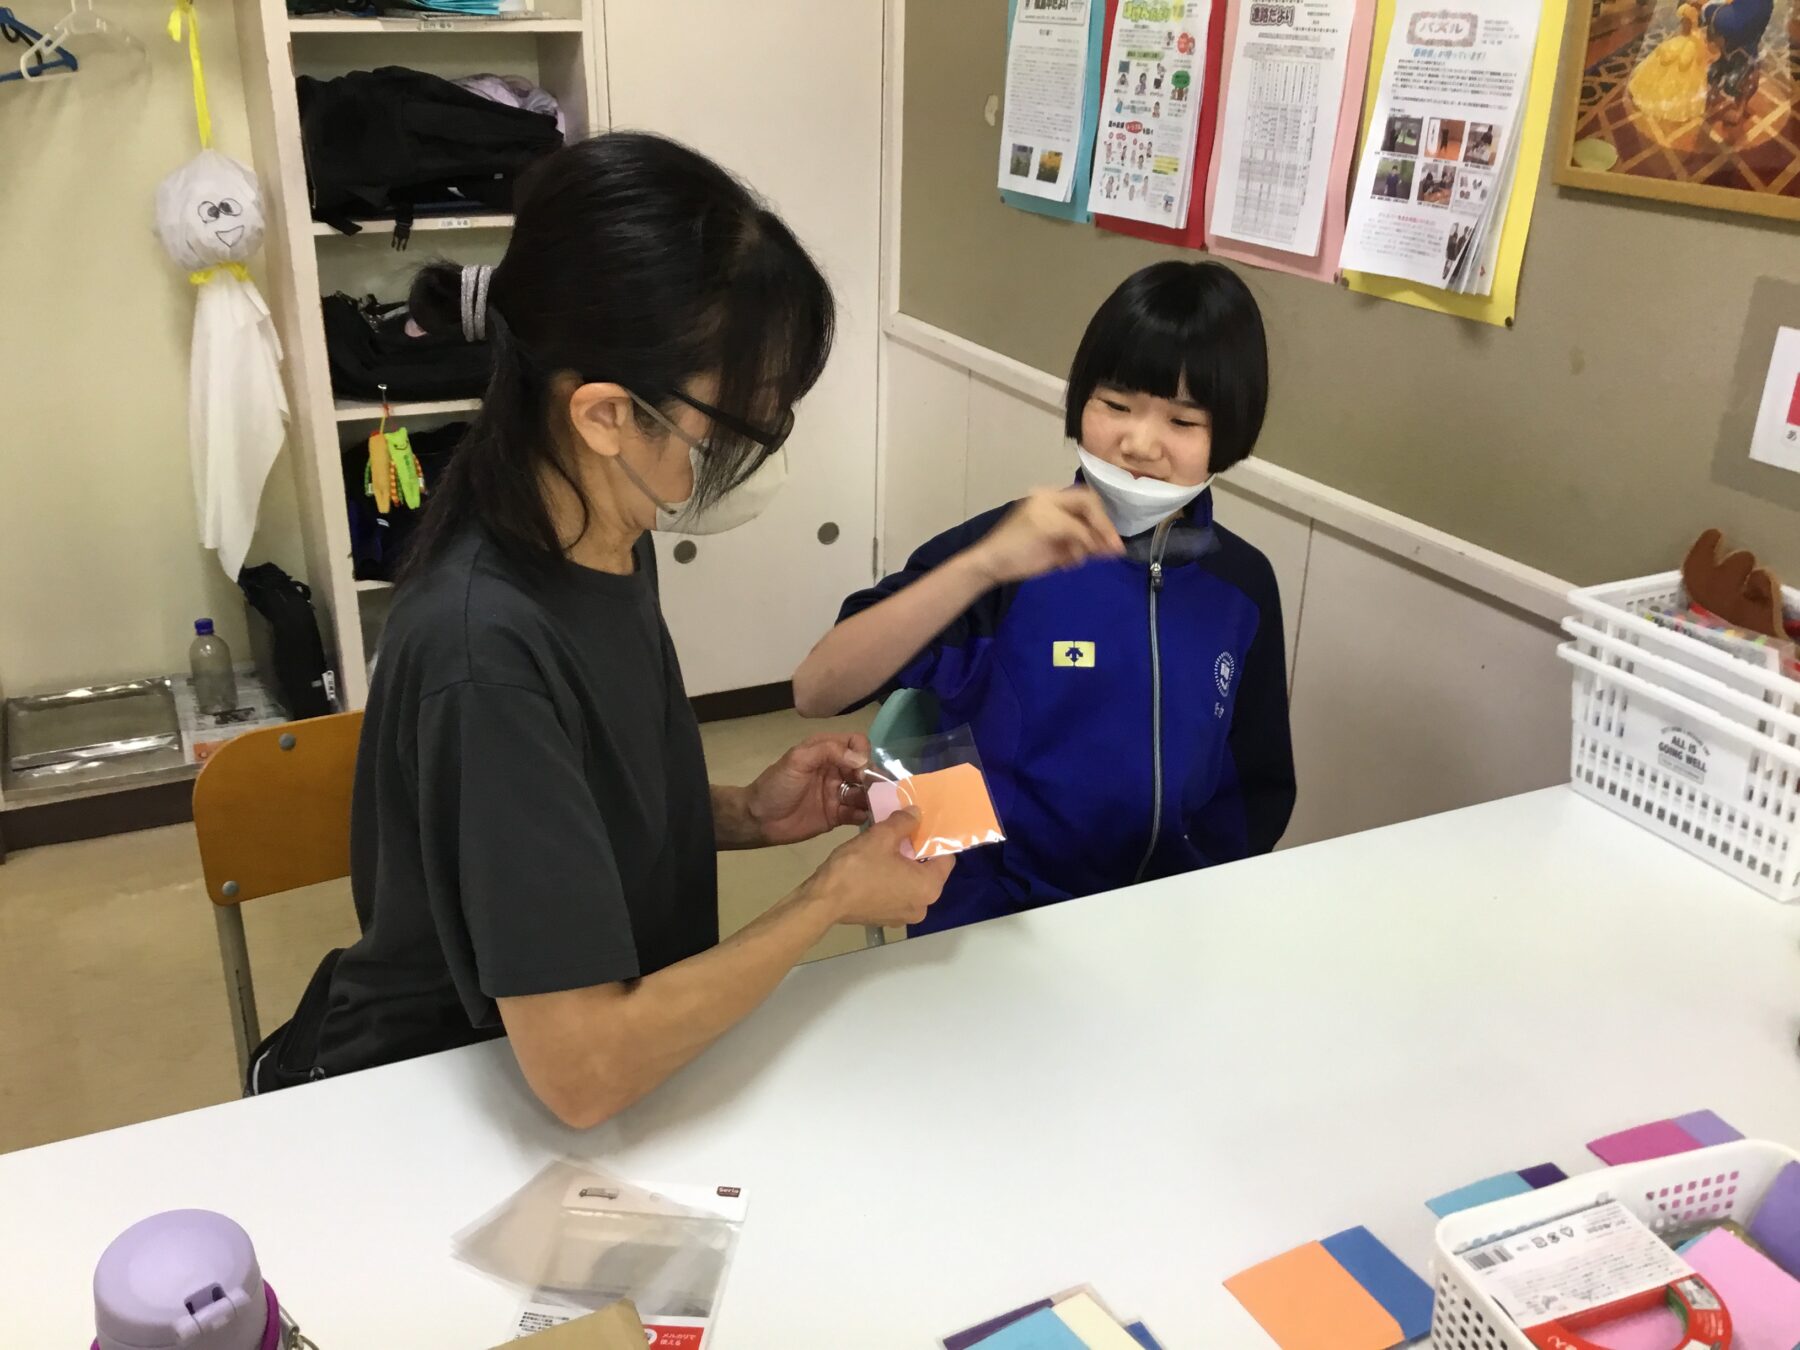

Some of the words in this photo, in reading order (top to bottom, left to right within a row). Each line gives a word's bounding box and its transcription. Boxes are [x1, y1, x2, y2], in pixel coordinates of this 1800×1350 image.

[1251, 5, 1294, 26] 進路だより
[1419, 22, 1463, 34] パズル
[1671, 735, 1685, 750] ALL
[1688, 743, 1697, 754] IS
[1658, 741, 1683, 760] GOING
[1686, 754, 1707, 773] WELL
[660, 1338, 681, 1346] 使える
[662, 1332, 697, 1341] メルカリで
